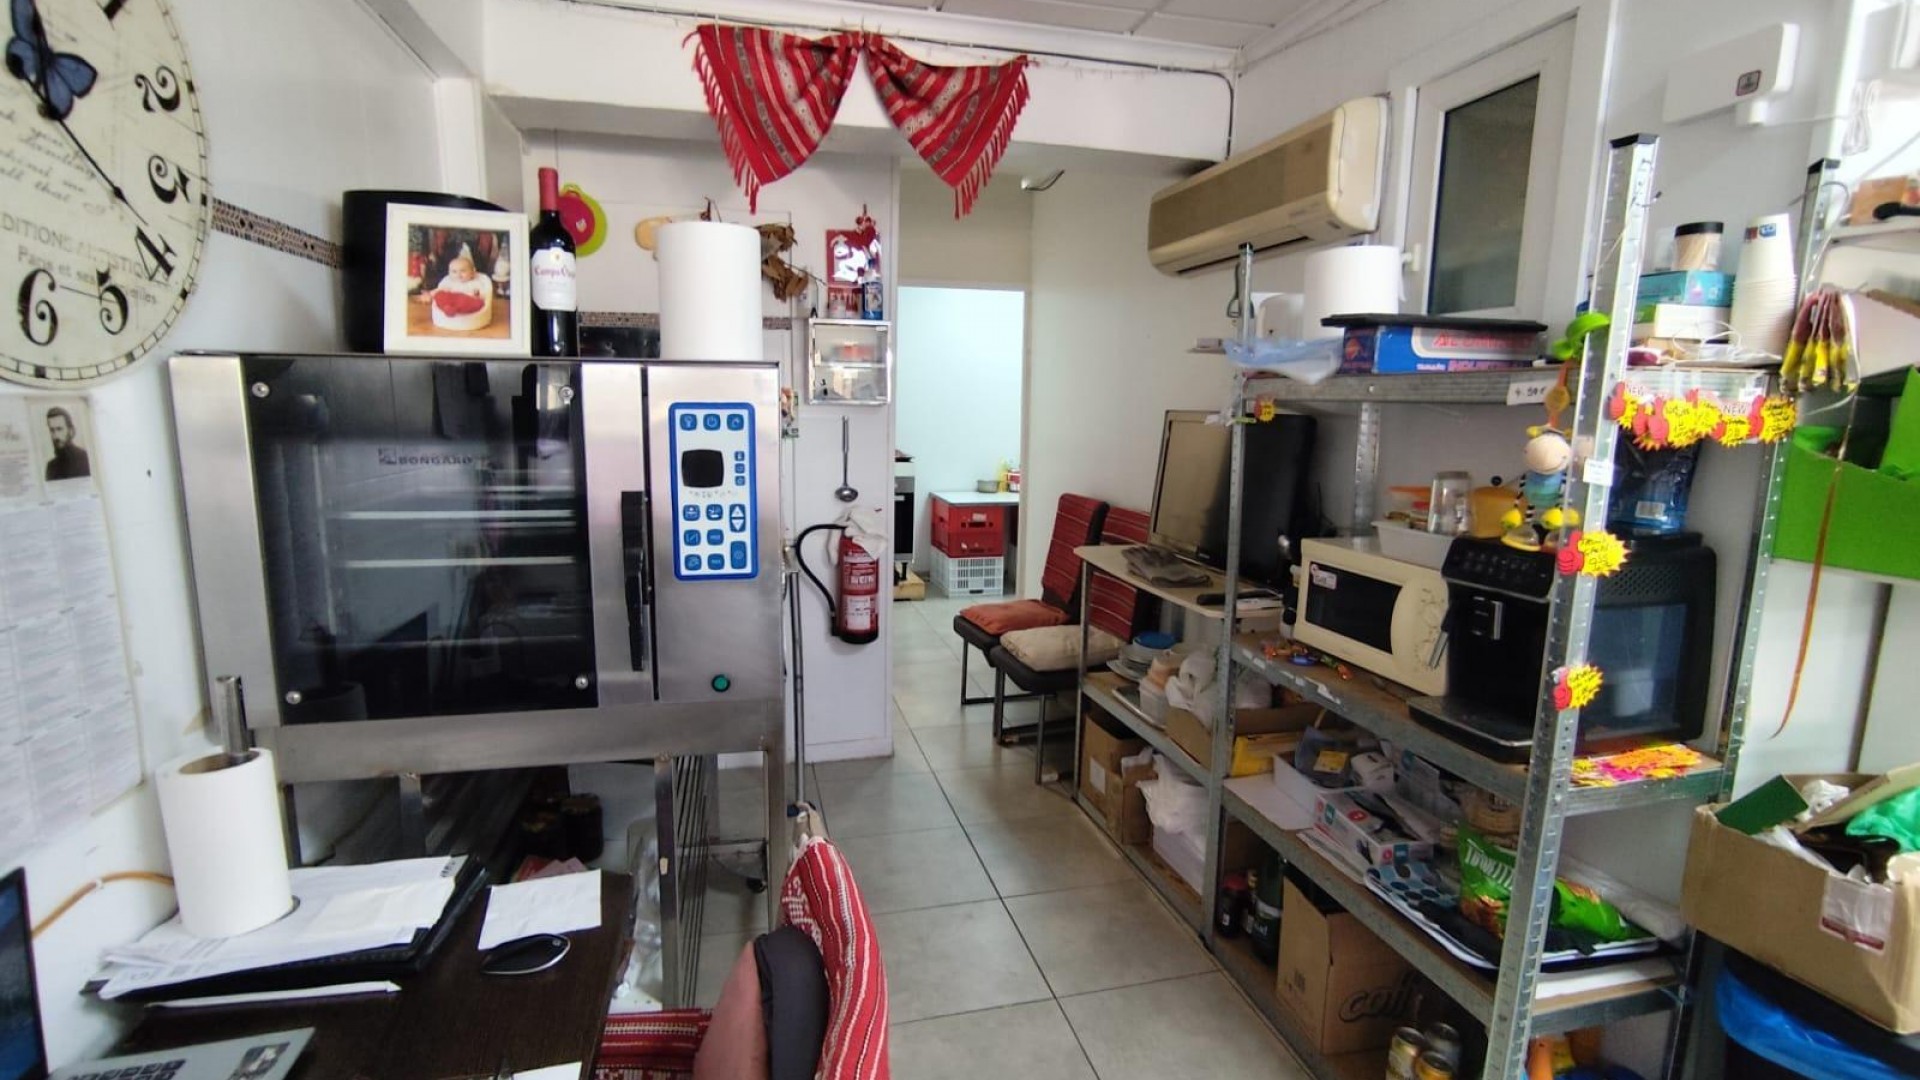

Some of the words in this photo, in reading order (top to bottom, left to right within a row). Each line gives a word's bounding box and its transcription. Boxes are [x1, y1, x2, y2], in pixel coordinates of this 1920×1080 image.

[134, 65, 181, 113] 2
[147, 154, 192, 205] 3
[134, 225, 178, 283] 4
[17, 269, 59, 346] 6
[99, 266, 129, 336] 5
